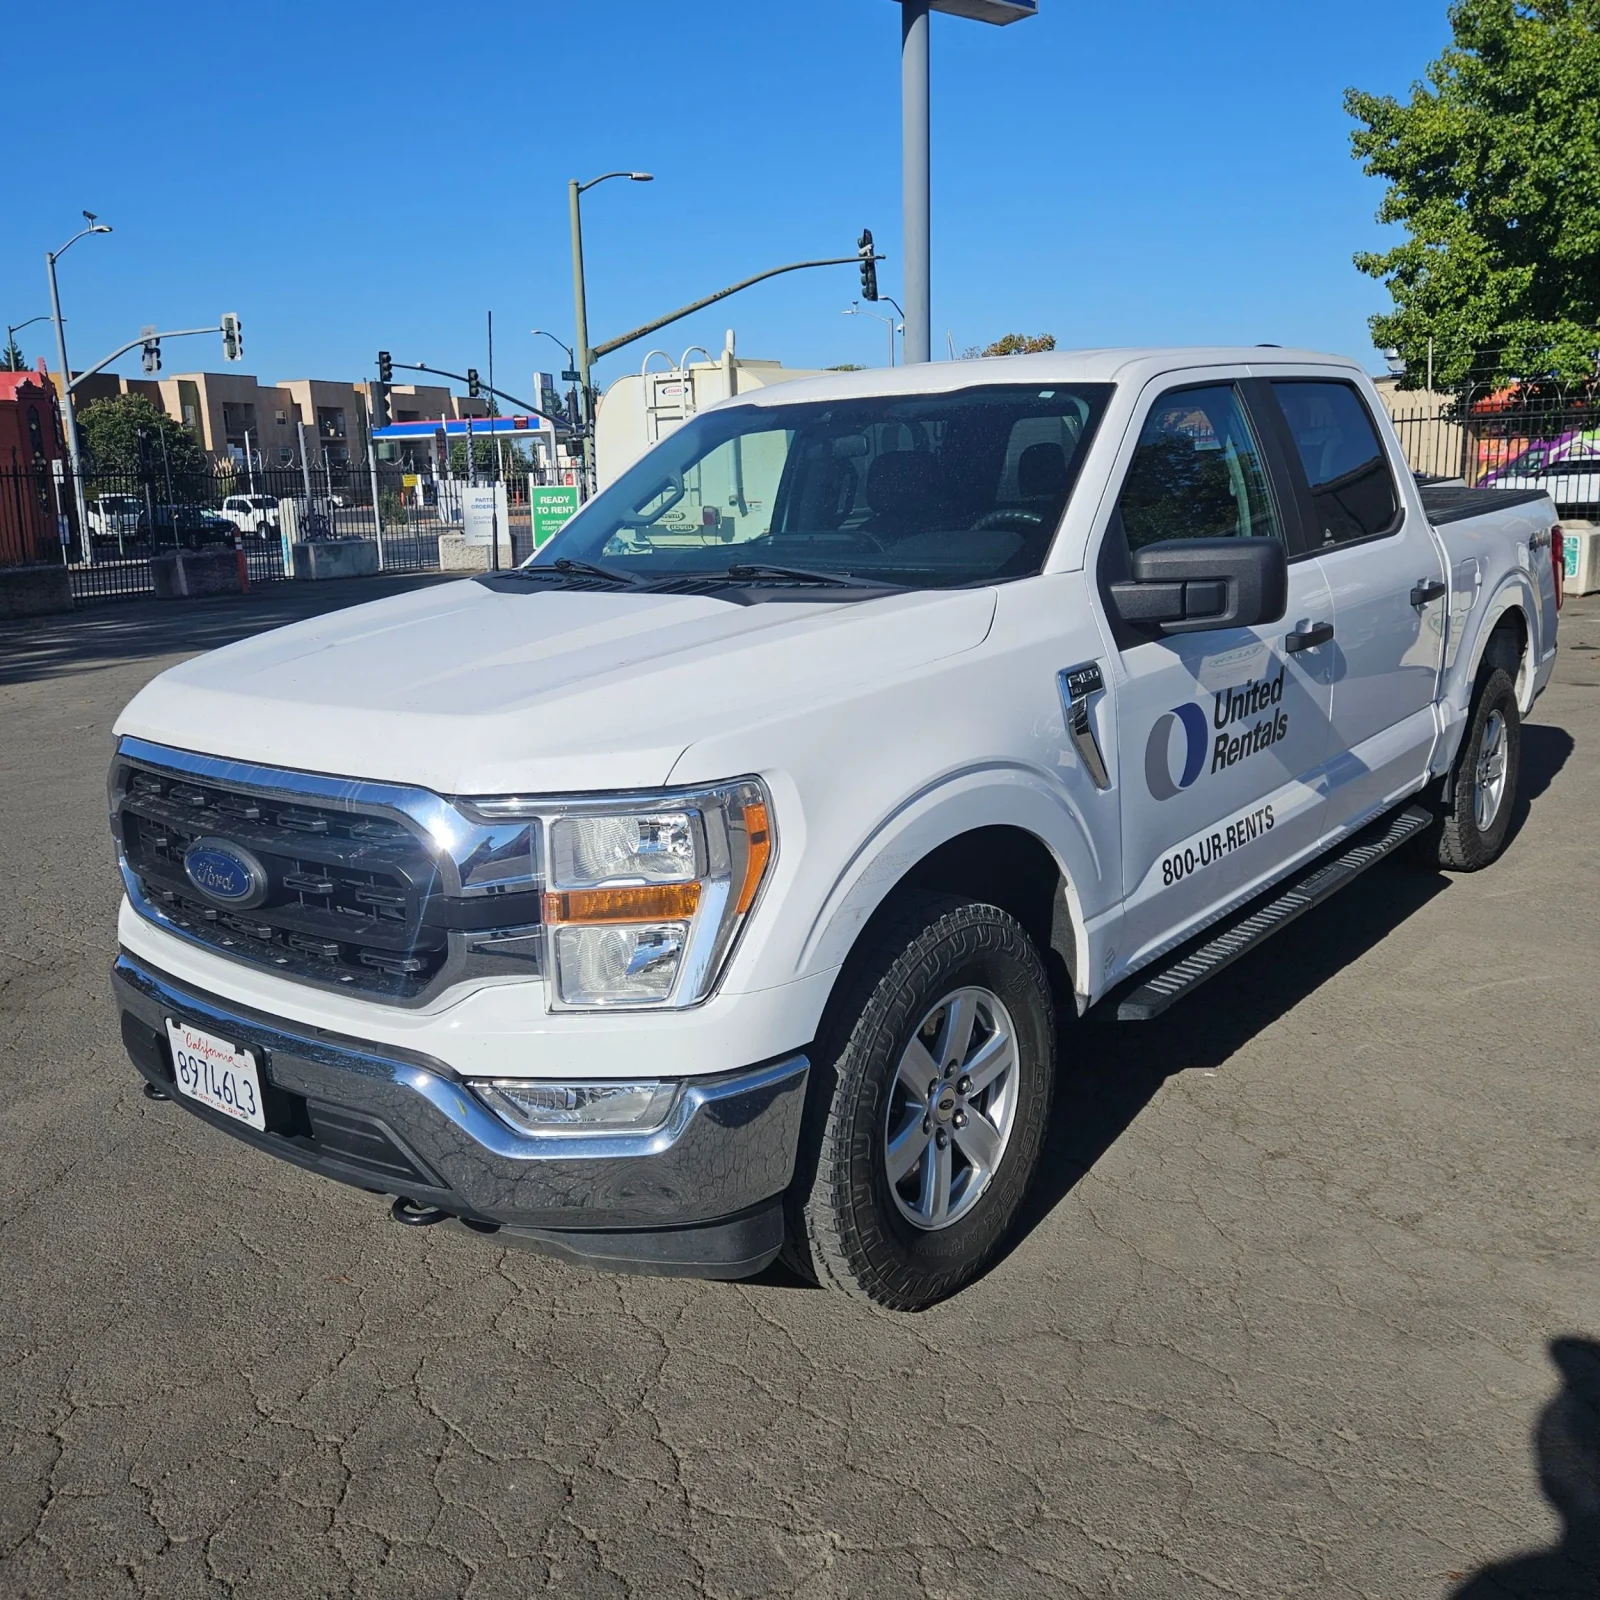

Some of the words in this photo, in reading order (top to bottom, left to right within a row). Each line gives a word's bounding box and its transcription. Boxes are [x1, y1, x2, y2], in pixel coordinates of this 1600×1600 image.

[536, 506, 549, 514] TO
[551, 506, 574, 514] RENT
[540, 496, 570, 504] READY
[1213, 665, 1285, 731] United
[1210, 706, 1289, 775] Rentals
[1161, 804, 1275, 887] 800-UR-RENTS
[196, 855, 235, 892] Ford
[185, 1031, 241, 1069] California
[177, 1050, 257, 1117] 89746L3
